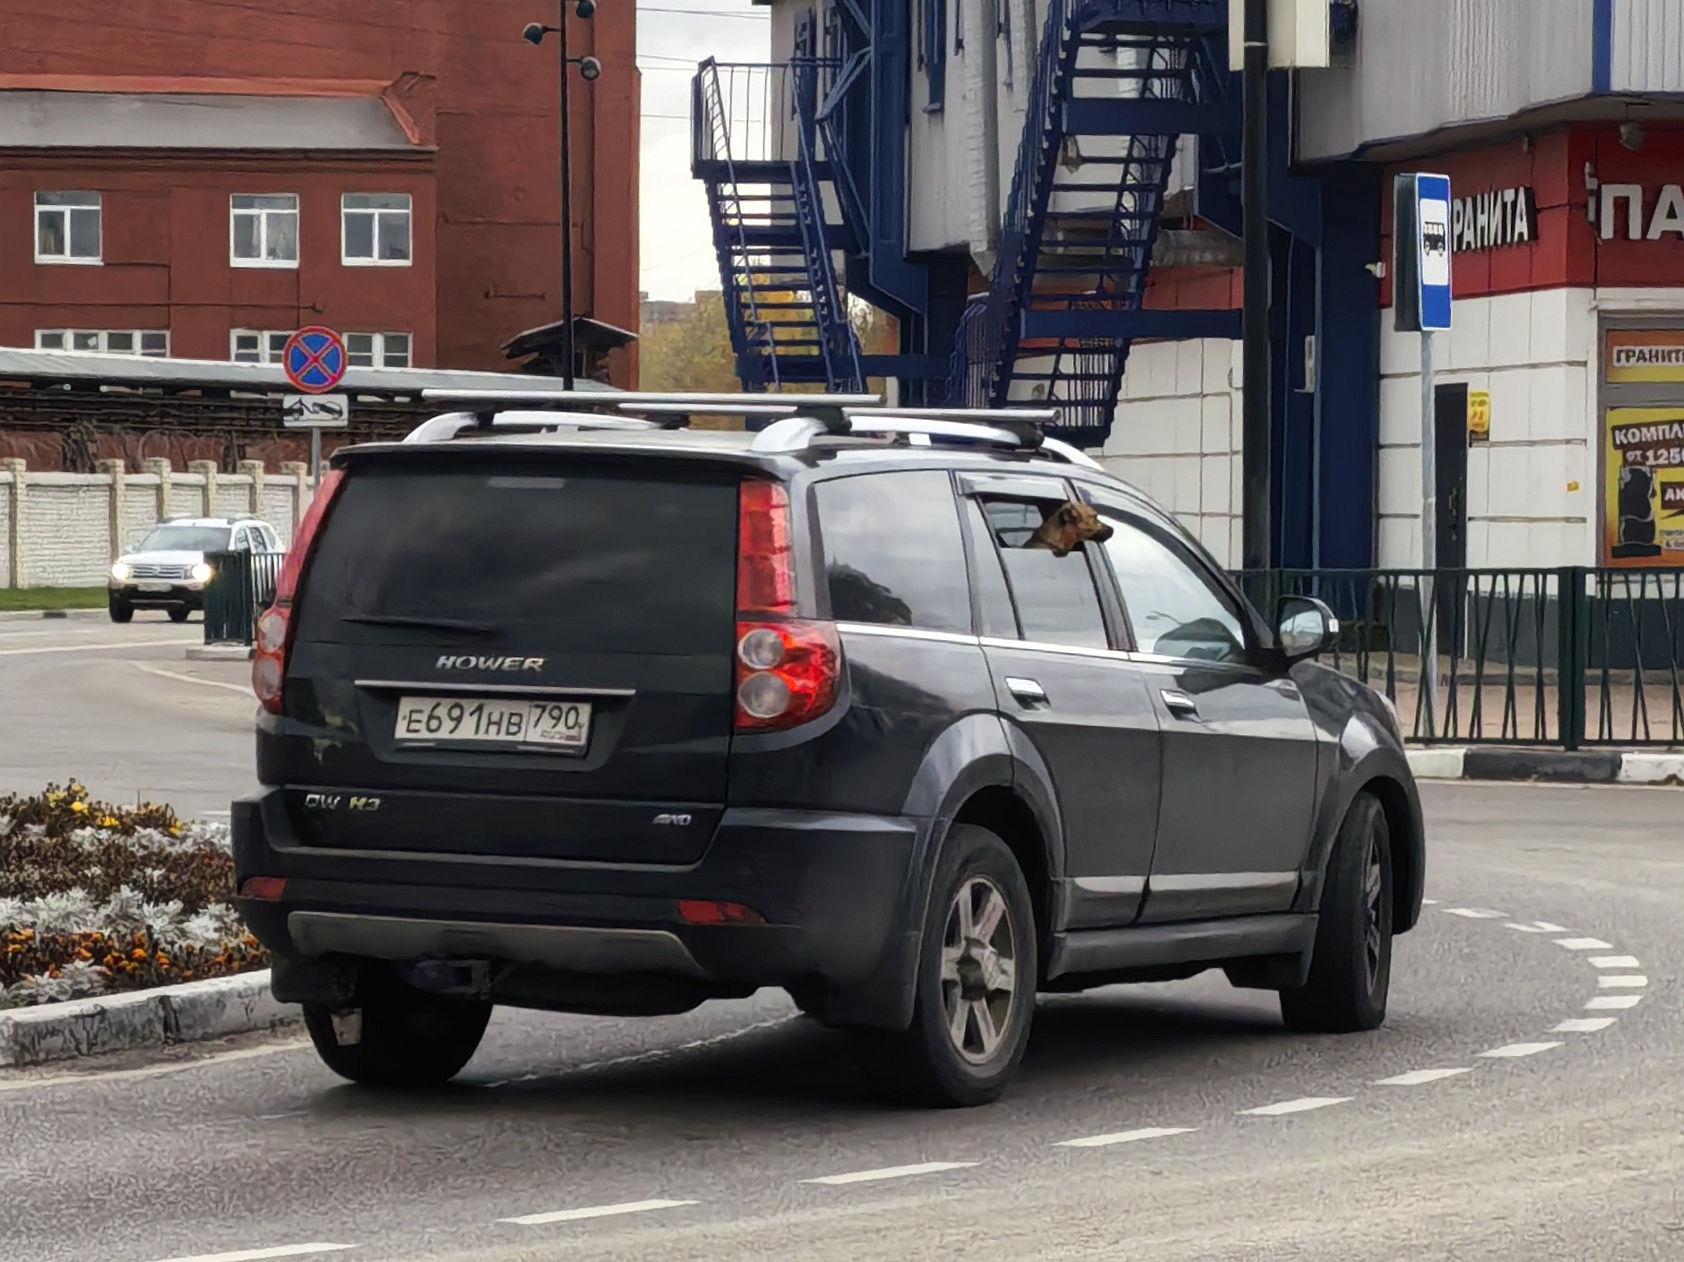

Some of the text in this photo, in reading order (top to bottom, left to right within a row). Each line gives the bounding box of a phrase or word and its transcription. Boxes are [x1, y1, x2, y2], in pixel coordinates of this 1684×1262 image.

[1616, 348, 1684, 364] ГРАНИТ
[1614, 422, 1684, 445] КОМПЛ
[435, 655, 547, 672] HOWER
[533, 703, 580, 730] 790
